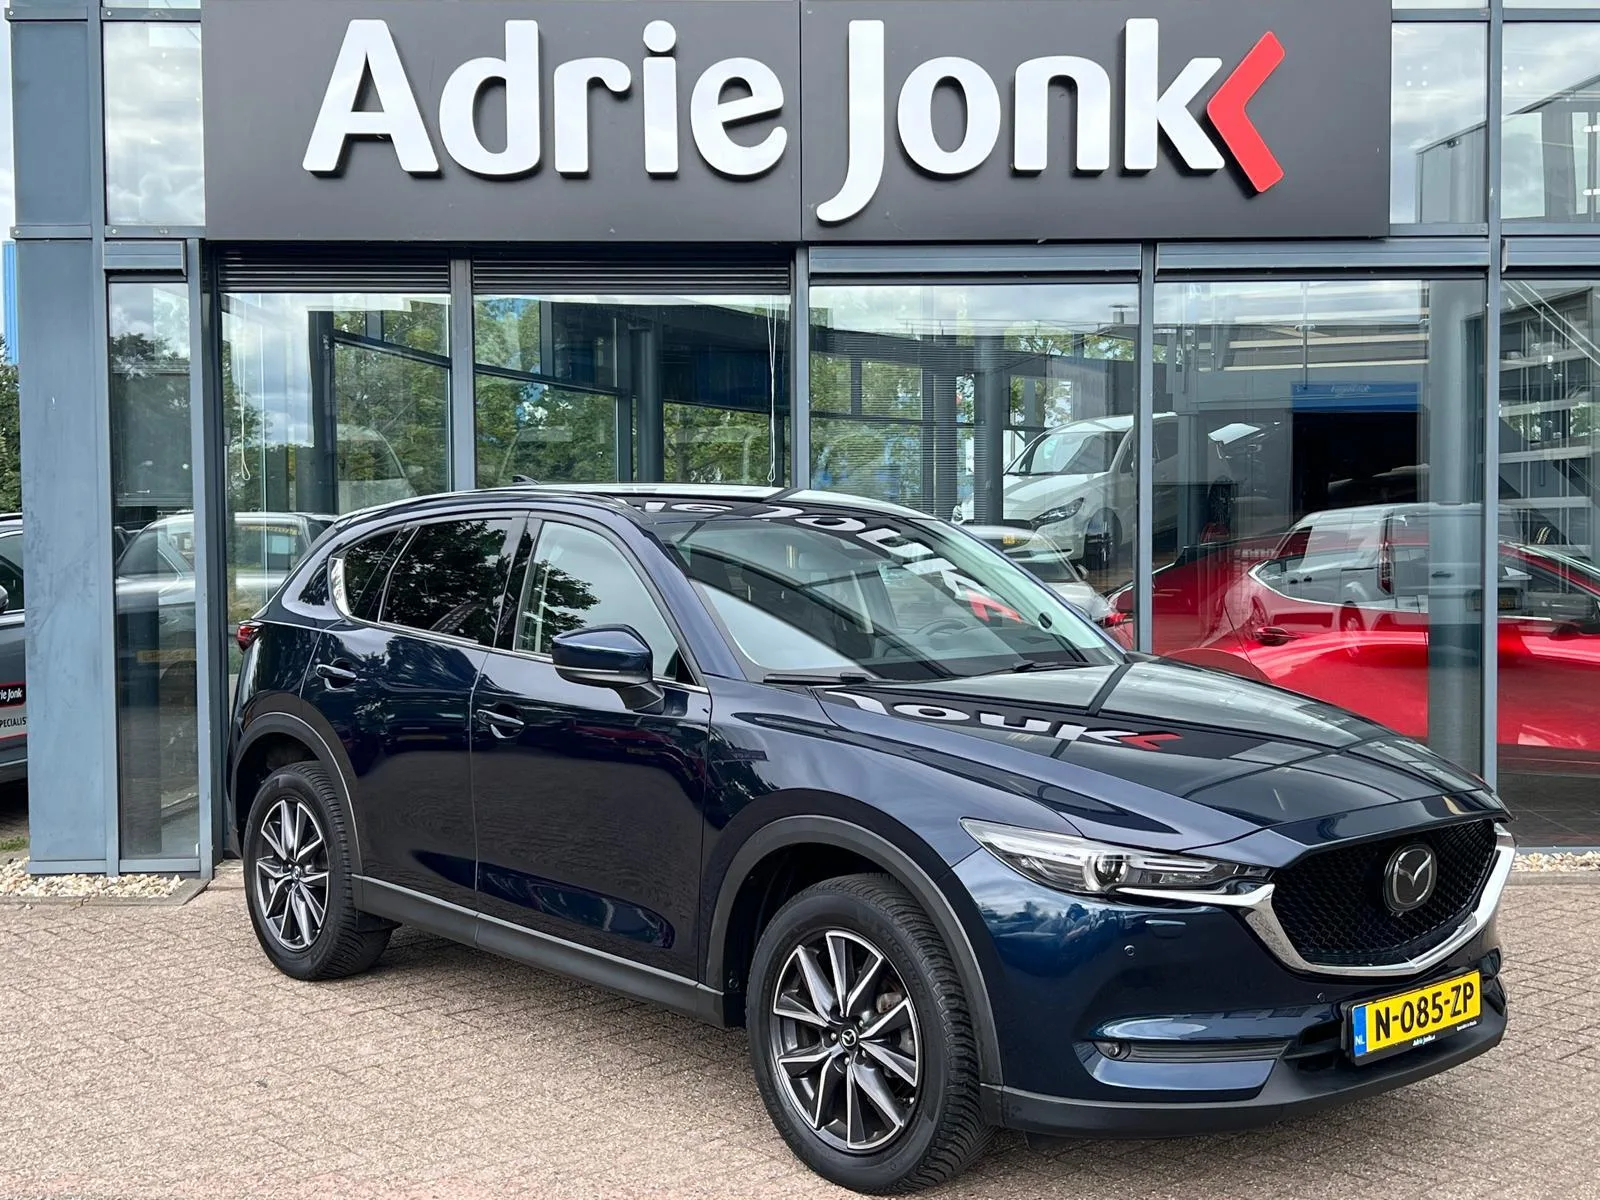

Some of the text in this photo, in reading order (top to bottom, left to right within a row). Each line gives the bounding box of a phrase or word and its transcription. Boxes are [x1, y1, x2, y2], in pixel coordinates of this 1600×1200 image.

[302, 17, 1226, 222] Adrie Jonk
[1354, 1035, 1365, 1046] NL
[1375, 981, 1474, 1042] N-085-ZP
